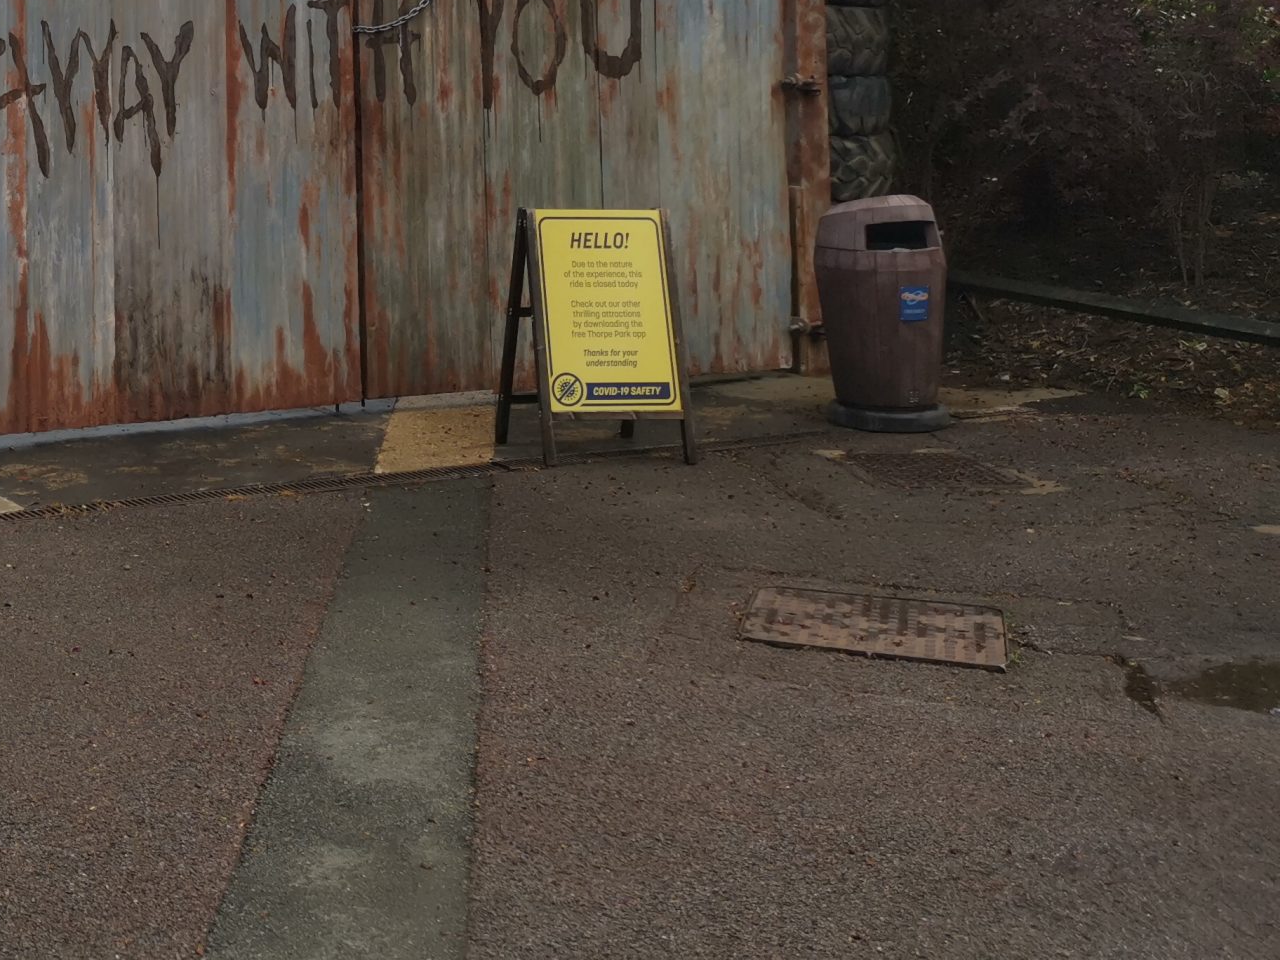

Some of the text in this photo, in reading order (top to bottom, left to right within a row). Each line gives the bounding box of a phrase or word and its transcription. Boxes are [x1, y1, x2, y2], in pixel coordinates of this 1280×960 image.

[570, 232, 629, 249] HELLO!
[571, 260, 586, 268] Due
[596, 260, 608, 268] the
[570, 280, 584, 288] ride
[593, 280, 617, 288] closed
[618, 281, 639, 289] today
[570, 300, 593, 308] Check
[573, 310, 641, 319] thrilling attractions
[573, 320, 643, 329] by downloading the
[571, 330, 647, 340] free Thorpe Park app
[583, 349, 639, 358] Thanks for your
[586, 359, 638, 368] understanding
[593, 386, 661, 396] COVID-19 SAFETY
